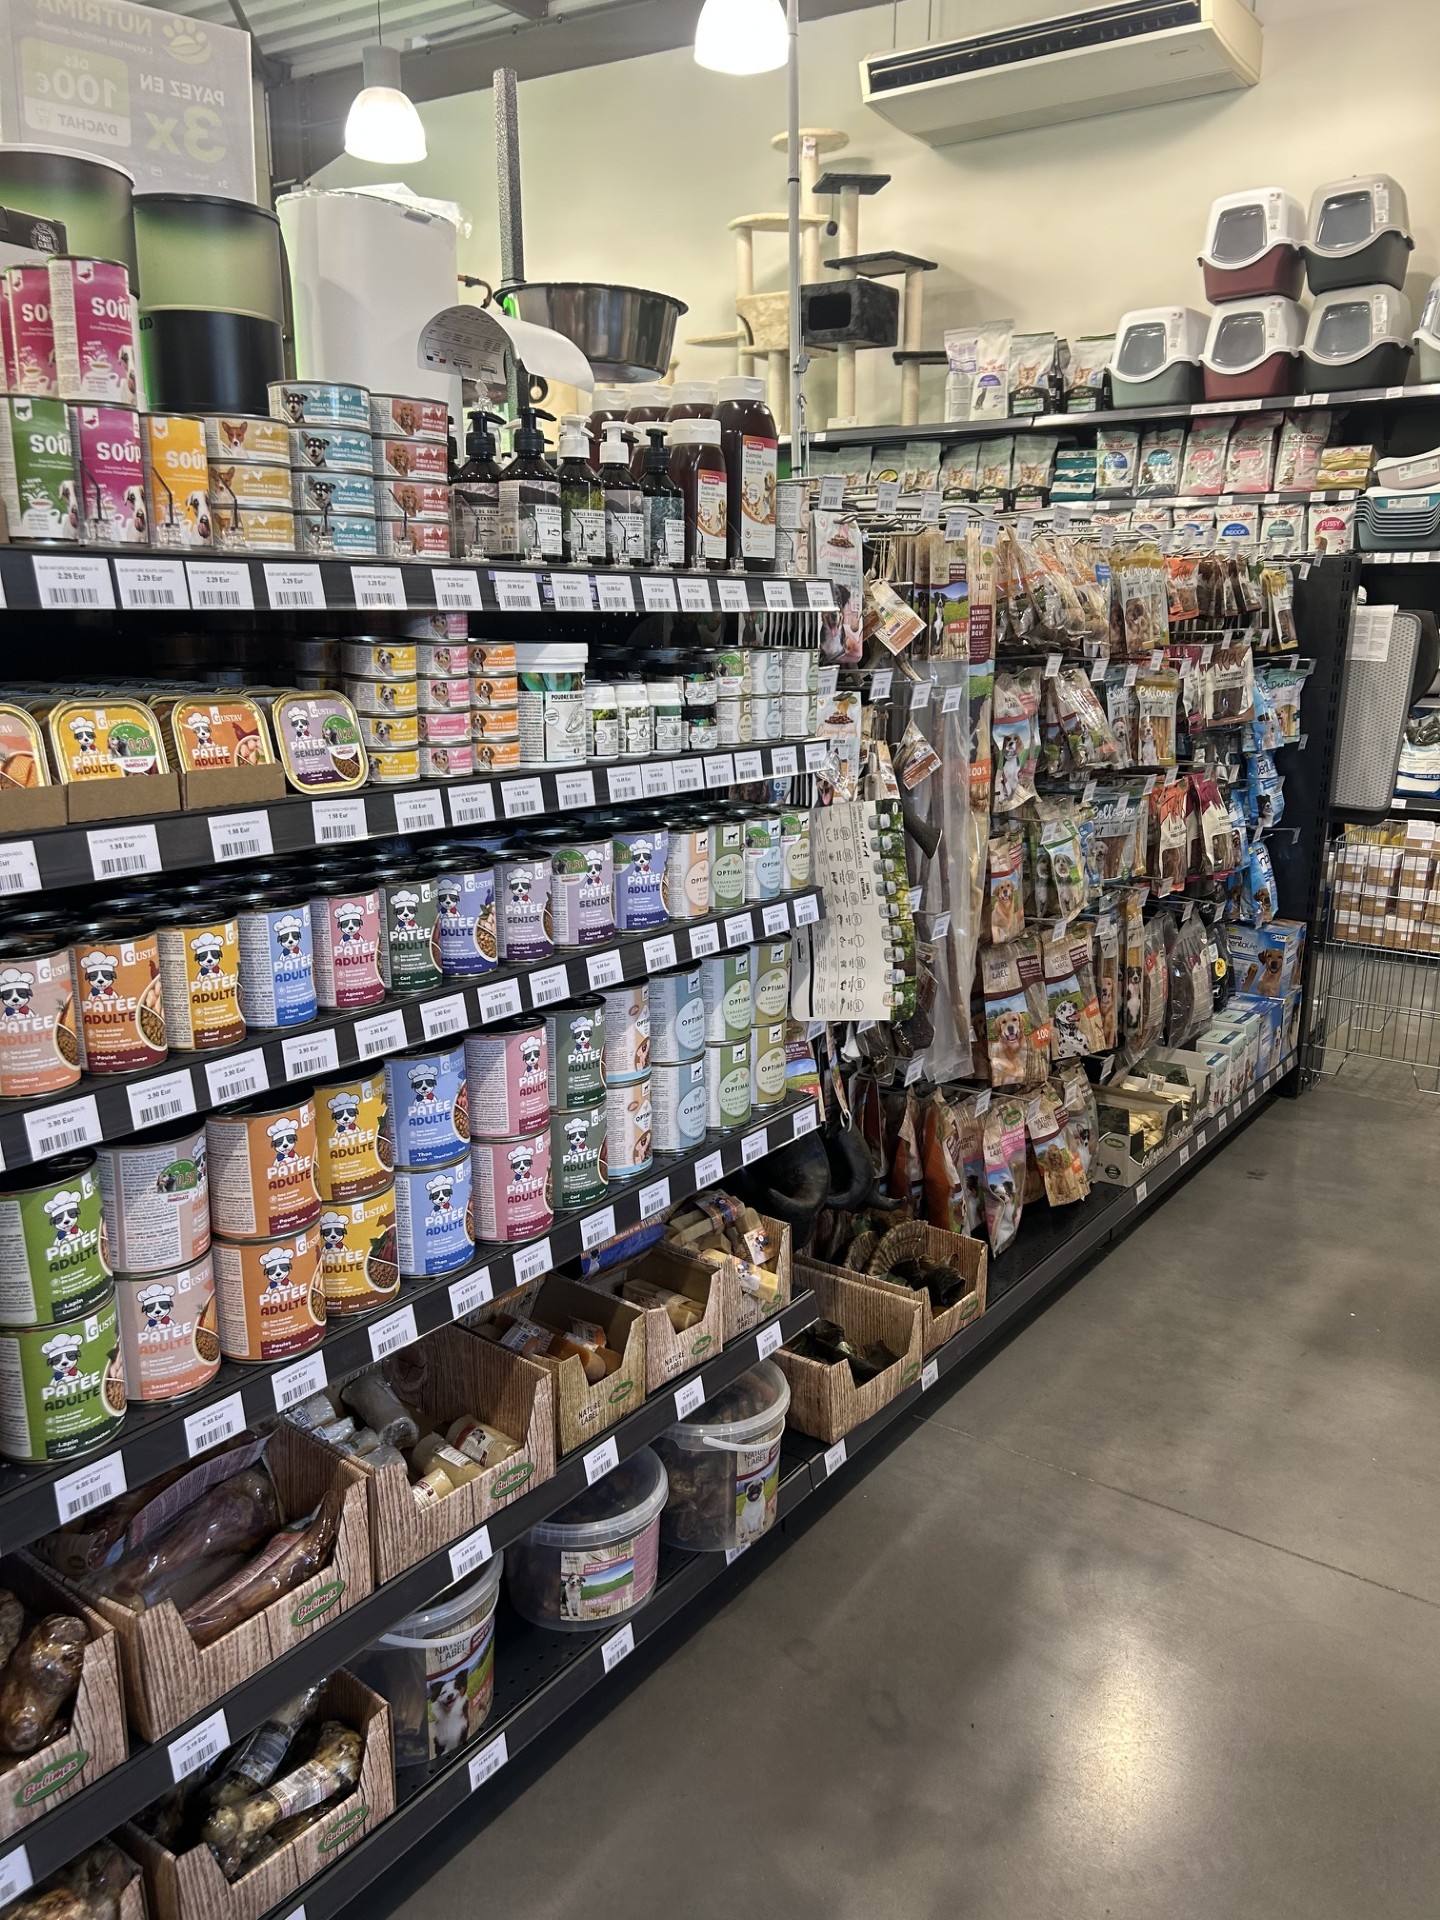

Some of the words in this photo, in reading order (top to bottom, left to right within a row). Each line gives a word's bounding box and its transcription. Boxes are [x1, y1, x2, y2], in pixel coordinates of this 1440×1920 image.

[1321, 519, 1339, 528] FUSSY
[213, 713, 242, 723] GUSTAV
[195, 756, 231, 767] ADULTE
[294, 749, 325, 758] SENIOR
[76, 764, 117, 776] ADULTE
[628, 883, 660, 895] ADULTE
[580, 896, 610, 909] SENIOR
[507, 915, 540, 924] SENIOR
[390, 927, 432, 942] PÂTÉE
[391, 941, 430, 951] ADULTE
[335, 953, 376, 967] ADULTE
[190, 973, 236, 993] PÂTÉE
[82, 995, 138, 1013] PÂTÉE
[192, 988, 236, 1004] ADULTE
[85, 1011, 137, 1025] ADULTE
[567, 1049, 601, 1065] PÂTÉE
[568, 1061, 600, 1073] ADULTE
[160, 1088, 171, 1096] Eur
[520, 1081, 547, 1097] ADULTE
[408, 1100, 452, 1117] PÂTÉE
[62, 1116, 74, 1124] Eur
[409, 1111, 451, 1127] ADULTE
[329, 1129, 375, 1149] PÂTÉE
[330, 1141, 375, 1160] ADULTE
[563, 1148, 598, 1165] PÂTÉE
[267, 1155, 311, 1180] PÂTÉE
[563, 1161, 598, 1173] ADULTE
[268, 1169, 312, 1191] ADULTE
[507, 1176, 544, 1195] PÂTÉE
[507, 1188, 544, 1205] ADULTE
[354, 1203, 389, 1221] GUSTAV
[425, 1207, 464, 1228] PÂTÉE
[426, 1220, 464, 1237] ADULTE
[46, 1228, 98, 1261] PÂTÉE
[49, 1245, 99, 1273] ADULTE
[259, 1282, 308, 1305] PÂTÉE
[261, 1296, 308, 1316] ADULTE
[138, 1322, 192, 1344] PÂTÉE
[140, 1335, 193, 1355] ADULTE
[298, 1370, 308, 1379] Eur
[42, 1369, 101, 1400] PÂTÉE
[45, 1385, 101, 1411] ADULTE
[215, 1412, 225, 1422] Eur
[58, 1438, 79, 1447] Lapin
[748, 1453, 767, 1469] LABEL
[90, 1474, 101, 1485] Eur
[440, 1646, 467, 1664] LABEL
[22, 1757, 79, 1801] Bubimex
[323, 1808, 364, 1846] Bubimex
